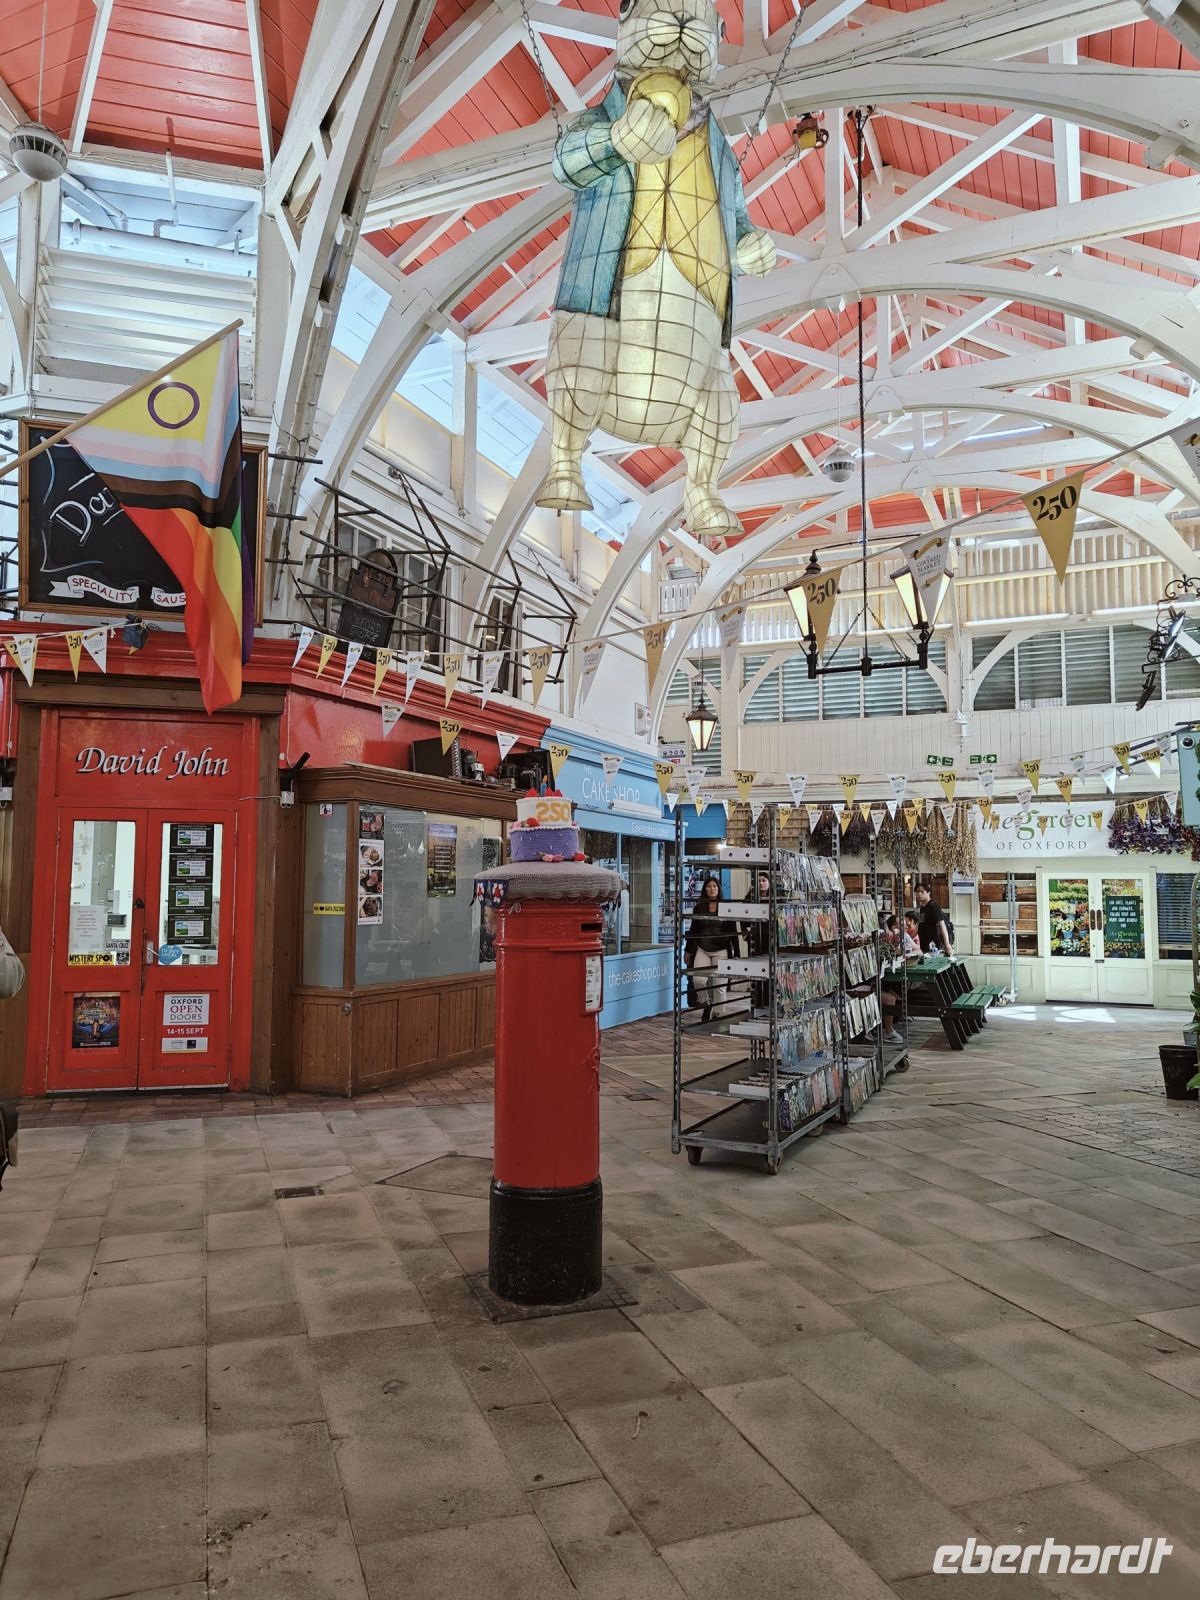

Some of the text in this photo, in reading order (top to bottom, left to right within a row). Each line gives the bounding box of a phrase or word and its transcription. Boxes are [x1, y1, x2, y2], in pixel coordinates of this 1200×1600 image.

[1032, 485, 1077, 521] 250
[72, 577, 134, 601] SPECIALITY
[807, 577, 836, 604] 250
[68, 635, 82, 648] 250
[647, 628, 665, 649] 250
[324, 639, 336, 652] 250
[378, 652, 391, 666] 250
[446, 657, 460, 673] 250
[531, 652, 549, 669] 250
[442, 719, 459, 733] 250
[551, 745, 568, 757] 250
[1114, 745, 1130, 755] 250
[1144, 750, 1160, 760] 250
[76, 746, 231, 779] David John
[1024, 763, 1039, 773] 250
[583, 765, 592, 774] THE
[656, 763, 673, 775] 250
[737, 773, 754, 784] 250
[841, 777, 857, 787] 250
[938, 773, 956, 784] 250
[1057, 779, 1072, 788] 250
[582, 777, 640, 804] CAKE SHOP
[536, 801, 571, 822] 250
[996, 841, 1087, 850] OF OXFORD
[69, 954, 113, 963] MYSTERY SPOT
[170, 1005, 203, 1013] OPEN
